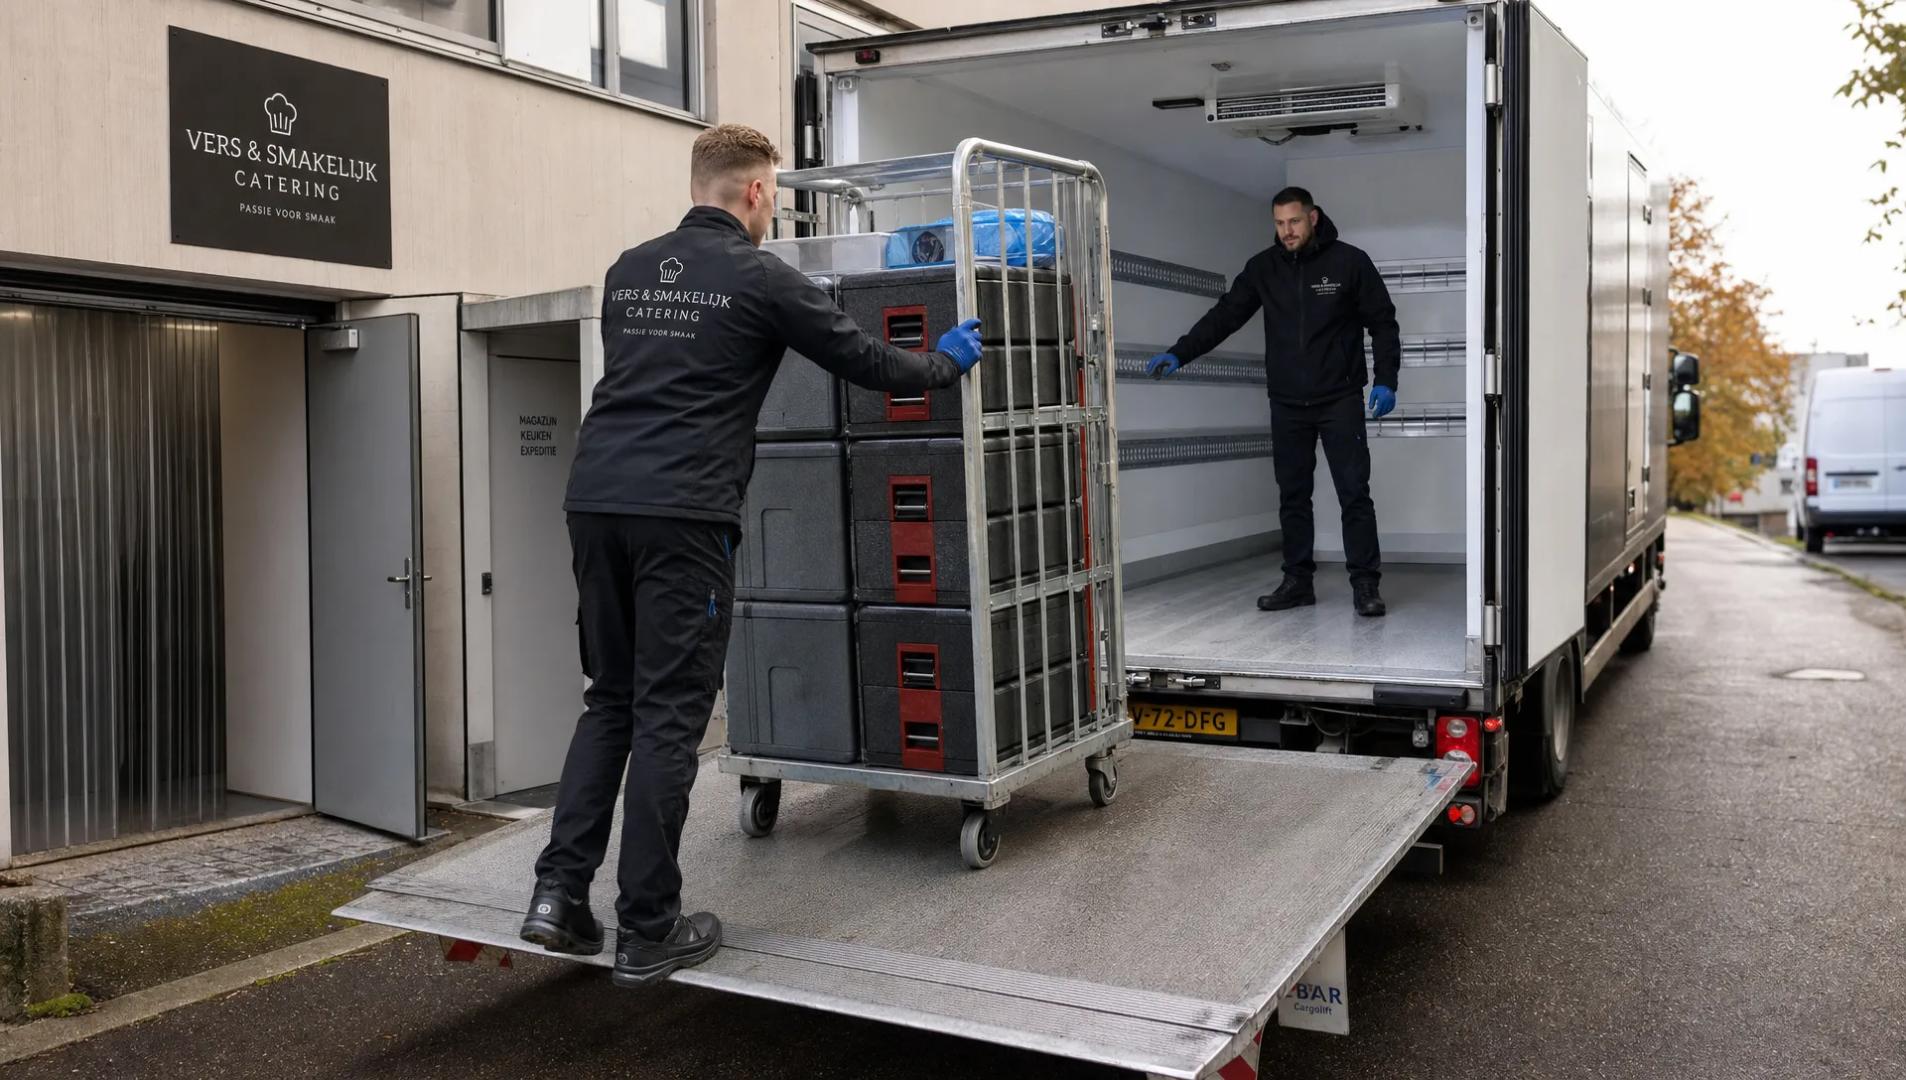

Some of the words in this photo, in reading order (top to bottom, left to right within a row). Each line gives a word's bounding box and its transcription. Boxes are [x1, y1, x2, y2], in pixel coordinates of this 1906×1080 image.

[186, 129, 241, 158] VERS
[247, 140, 262, 162] &
[266, 144, 378, 182] SMAKELIJK
[234, 170, 340, 201] CATERING
[239, 203, 271, 216] PASSIE
[275, 207, 301, 220] VOOR
[305, 212, 336, 224] SMAAK
[611, 289, 640, 301] VERS
[641, 289, 651, 301] &
[652, 289, 732, 309] SMAKELIJK
[625, 306, 700, 322] CATERING
[623, 328, 646, 336] PASSIE
[648, 328, 668, 337] VOOR
[670, 330, 696, 340] SMAAK
[520, 430, 552, 441] KEUKEN
[520, 445, 557, 456] EXPEDITIE
[1293, 1002, 1333, 1016] Cargolift
